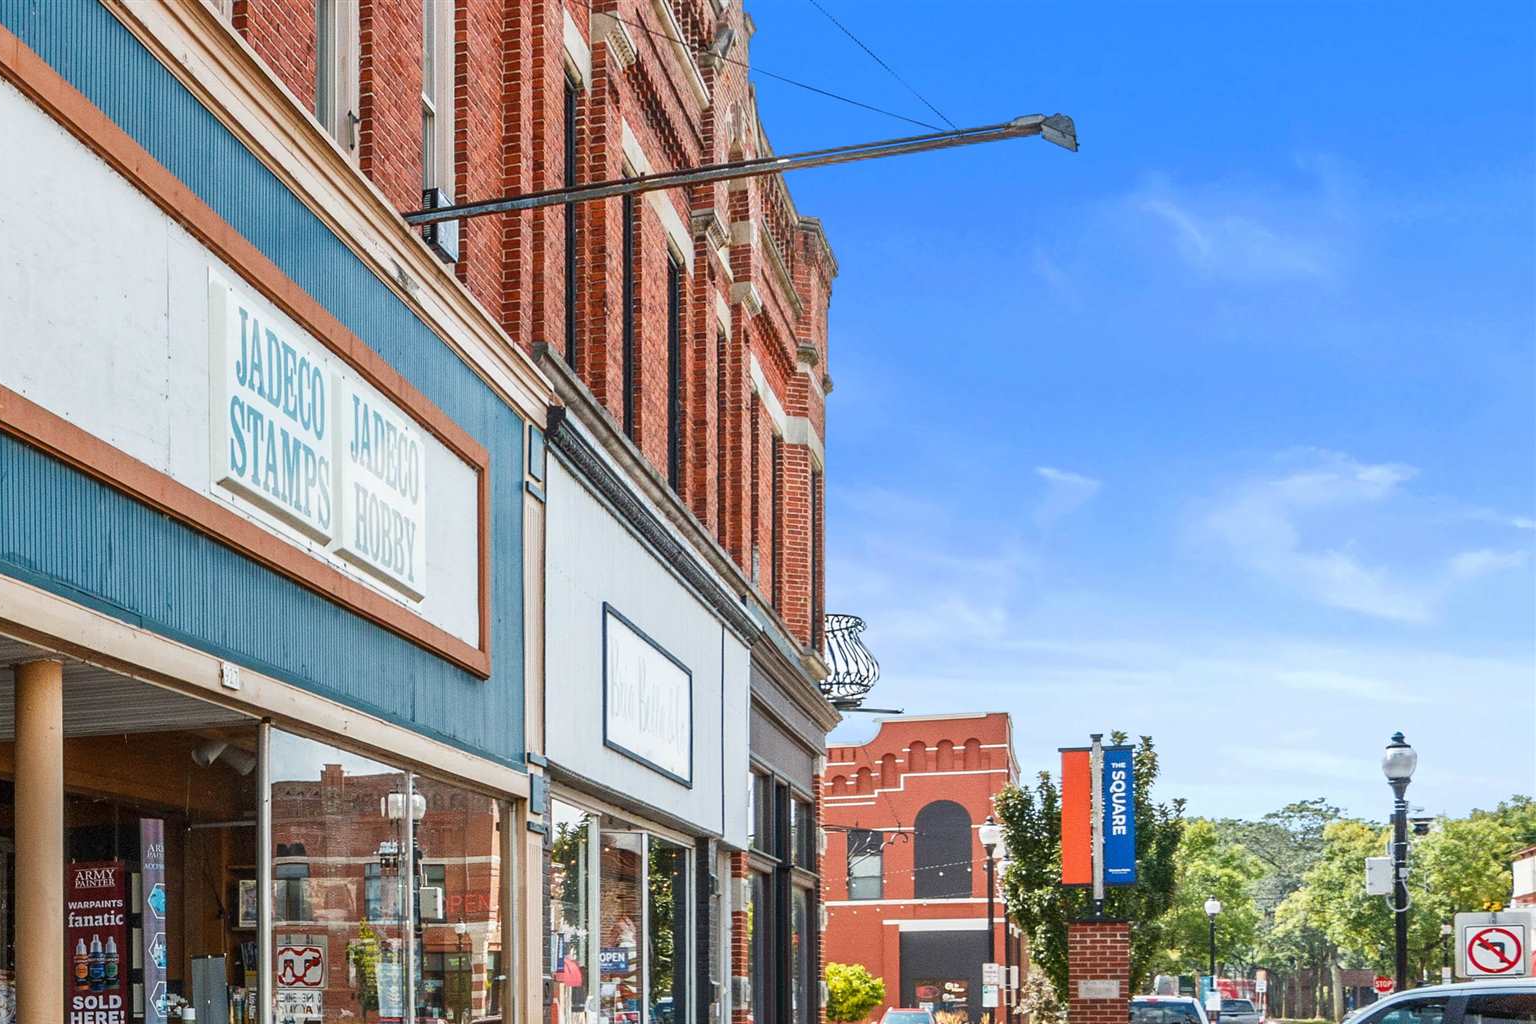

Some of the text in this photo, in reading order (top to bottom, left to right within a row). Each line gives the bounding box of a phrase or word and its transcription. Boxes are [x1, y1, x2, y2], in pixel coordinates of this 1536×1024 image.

[236, 306, 326, 440] JADECO
[350, 393, 420, 505] JADECO
[230, 396, 331, 530] STAMPS
[354, 481, 417, 582] HOBBY
[1110, 770, 1127, 836] SQUARE
[75, 868, 114, 881] ARMY
[74, 879, 116, 889] PAINTER
[67, 899, 124, 910] WARPAINTS
[67, 910, 124, 928] fanatic
[600, 952, 625, 963] OPEN
[1375, 980, 1393, 989] STOP
[72, 995, 122, 1010] SOLD
